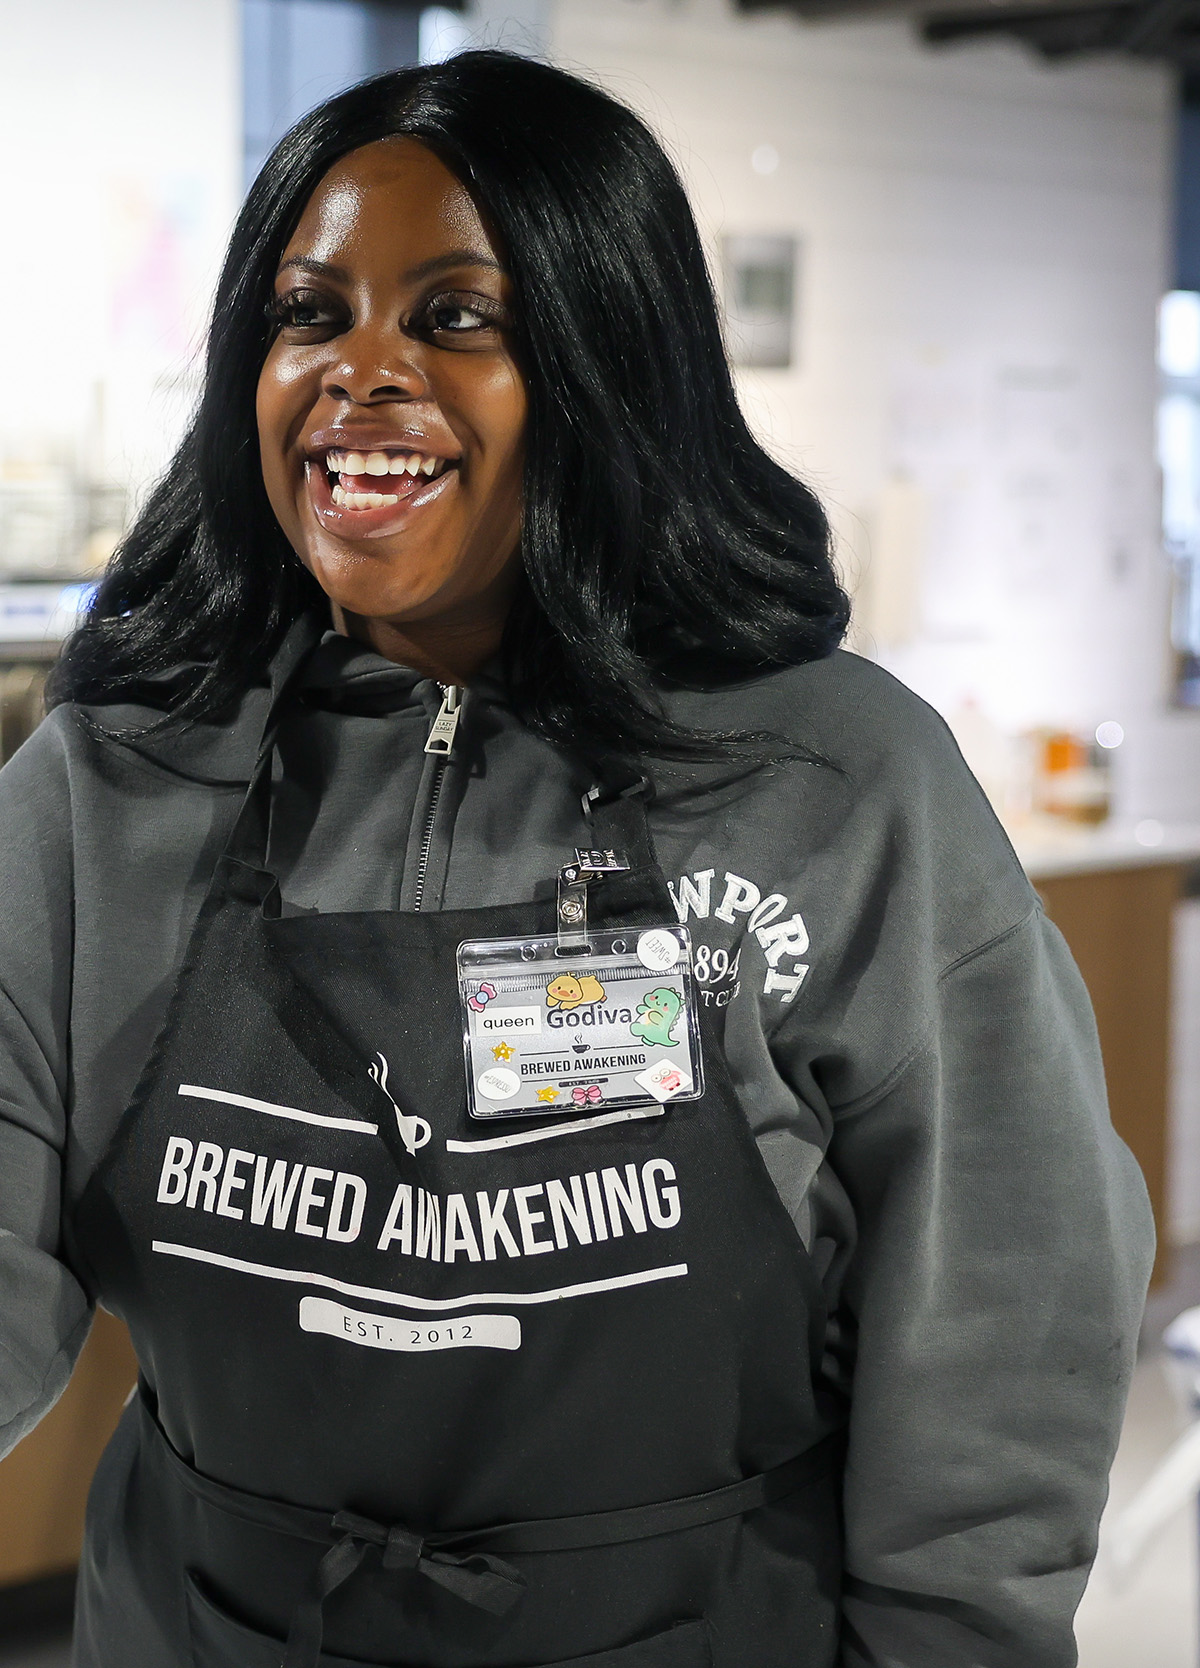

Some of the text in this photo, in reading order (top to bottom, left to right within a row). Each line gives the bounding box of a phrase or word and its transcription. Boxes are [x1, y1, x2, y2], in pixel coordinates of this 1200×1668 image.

[483, 1004, 632, 1030] queen Godiva
[520, 1053, 646, 1076] BREWED AWAKENING
[156, 1136, 682, 1264] BREWED AWAKENING
[343, 1315, 473, 1344] EST. 2012
